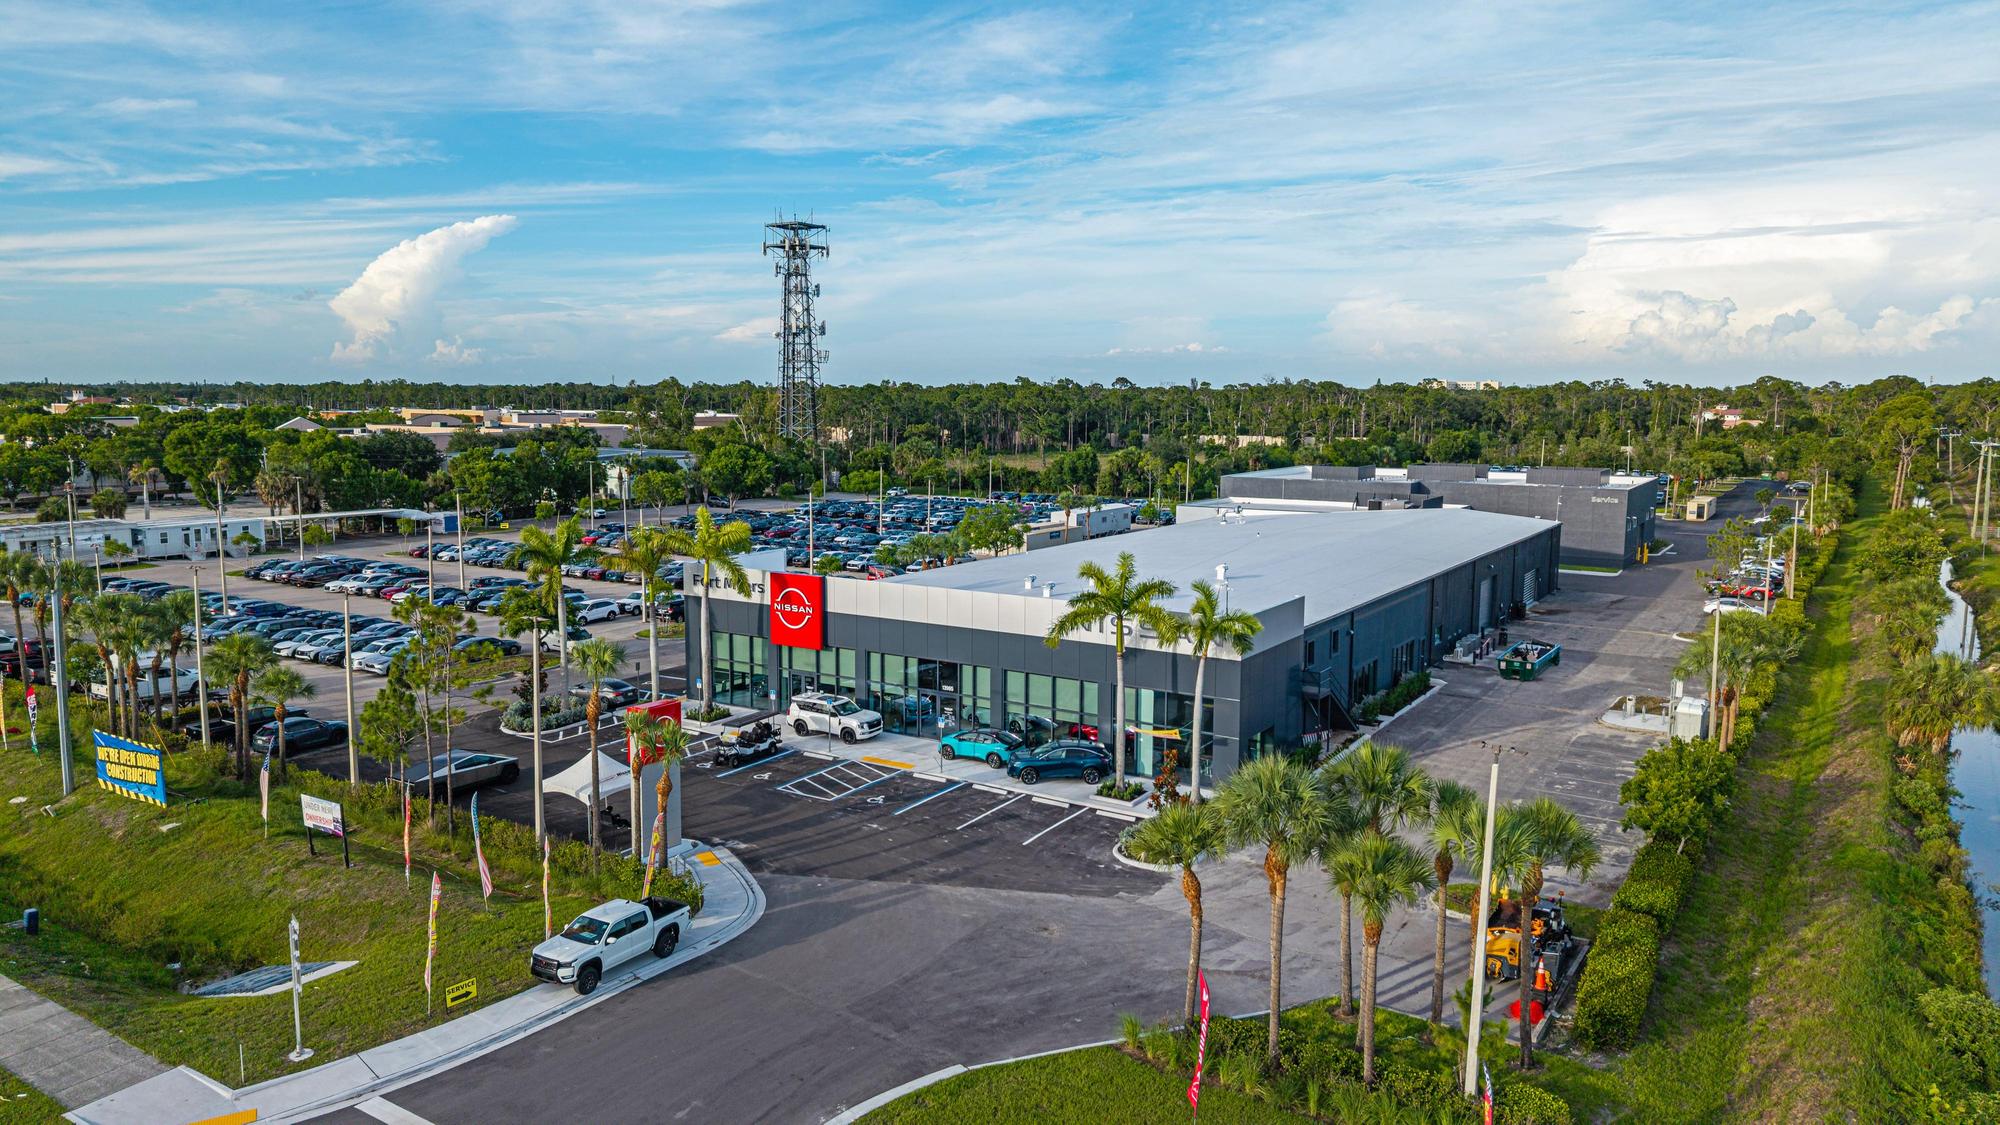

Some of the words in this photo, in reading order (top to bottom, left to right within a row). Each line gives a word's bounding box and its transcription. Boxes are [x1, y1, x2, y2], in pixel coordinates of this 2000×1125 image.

[1591, 496, 1619, 504] Service
[724, 578, 765, 595] Mrs
[774, 602, 813, 614] NISSAN
[1074, 612, 1224, 647] ISS
[97, 746, 120, 763] WE'RE
[120, 749, 136, 766] OPEN
[136, 752, 160, 770] DURING
[106, 763, 157, 785] CONSTRUCTION
[447, 980, 475, 995] SERVICE
